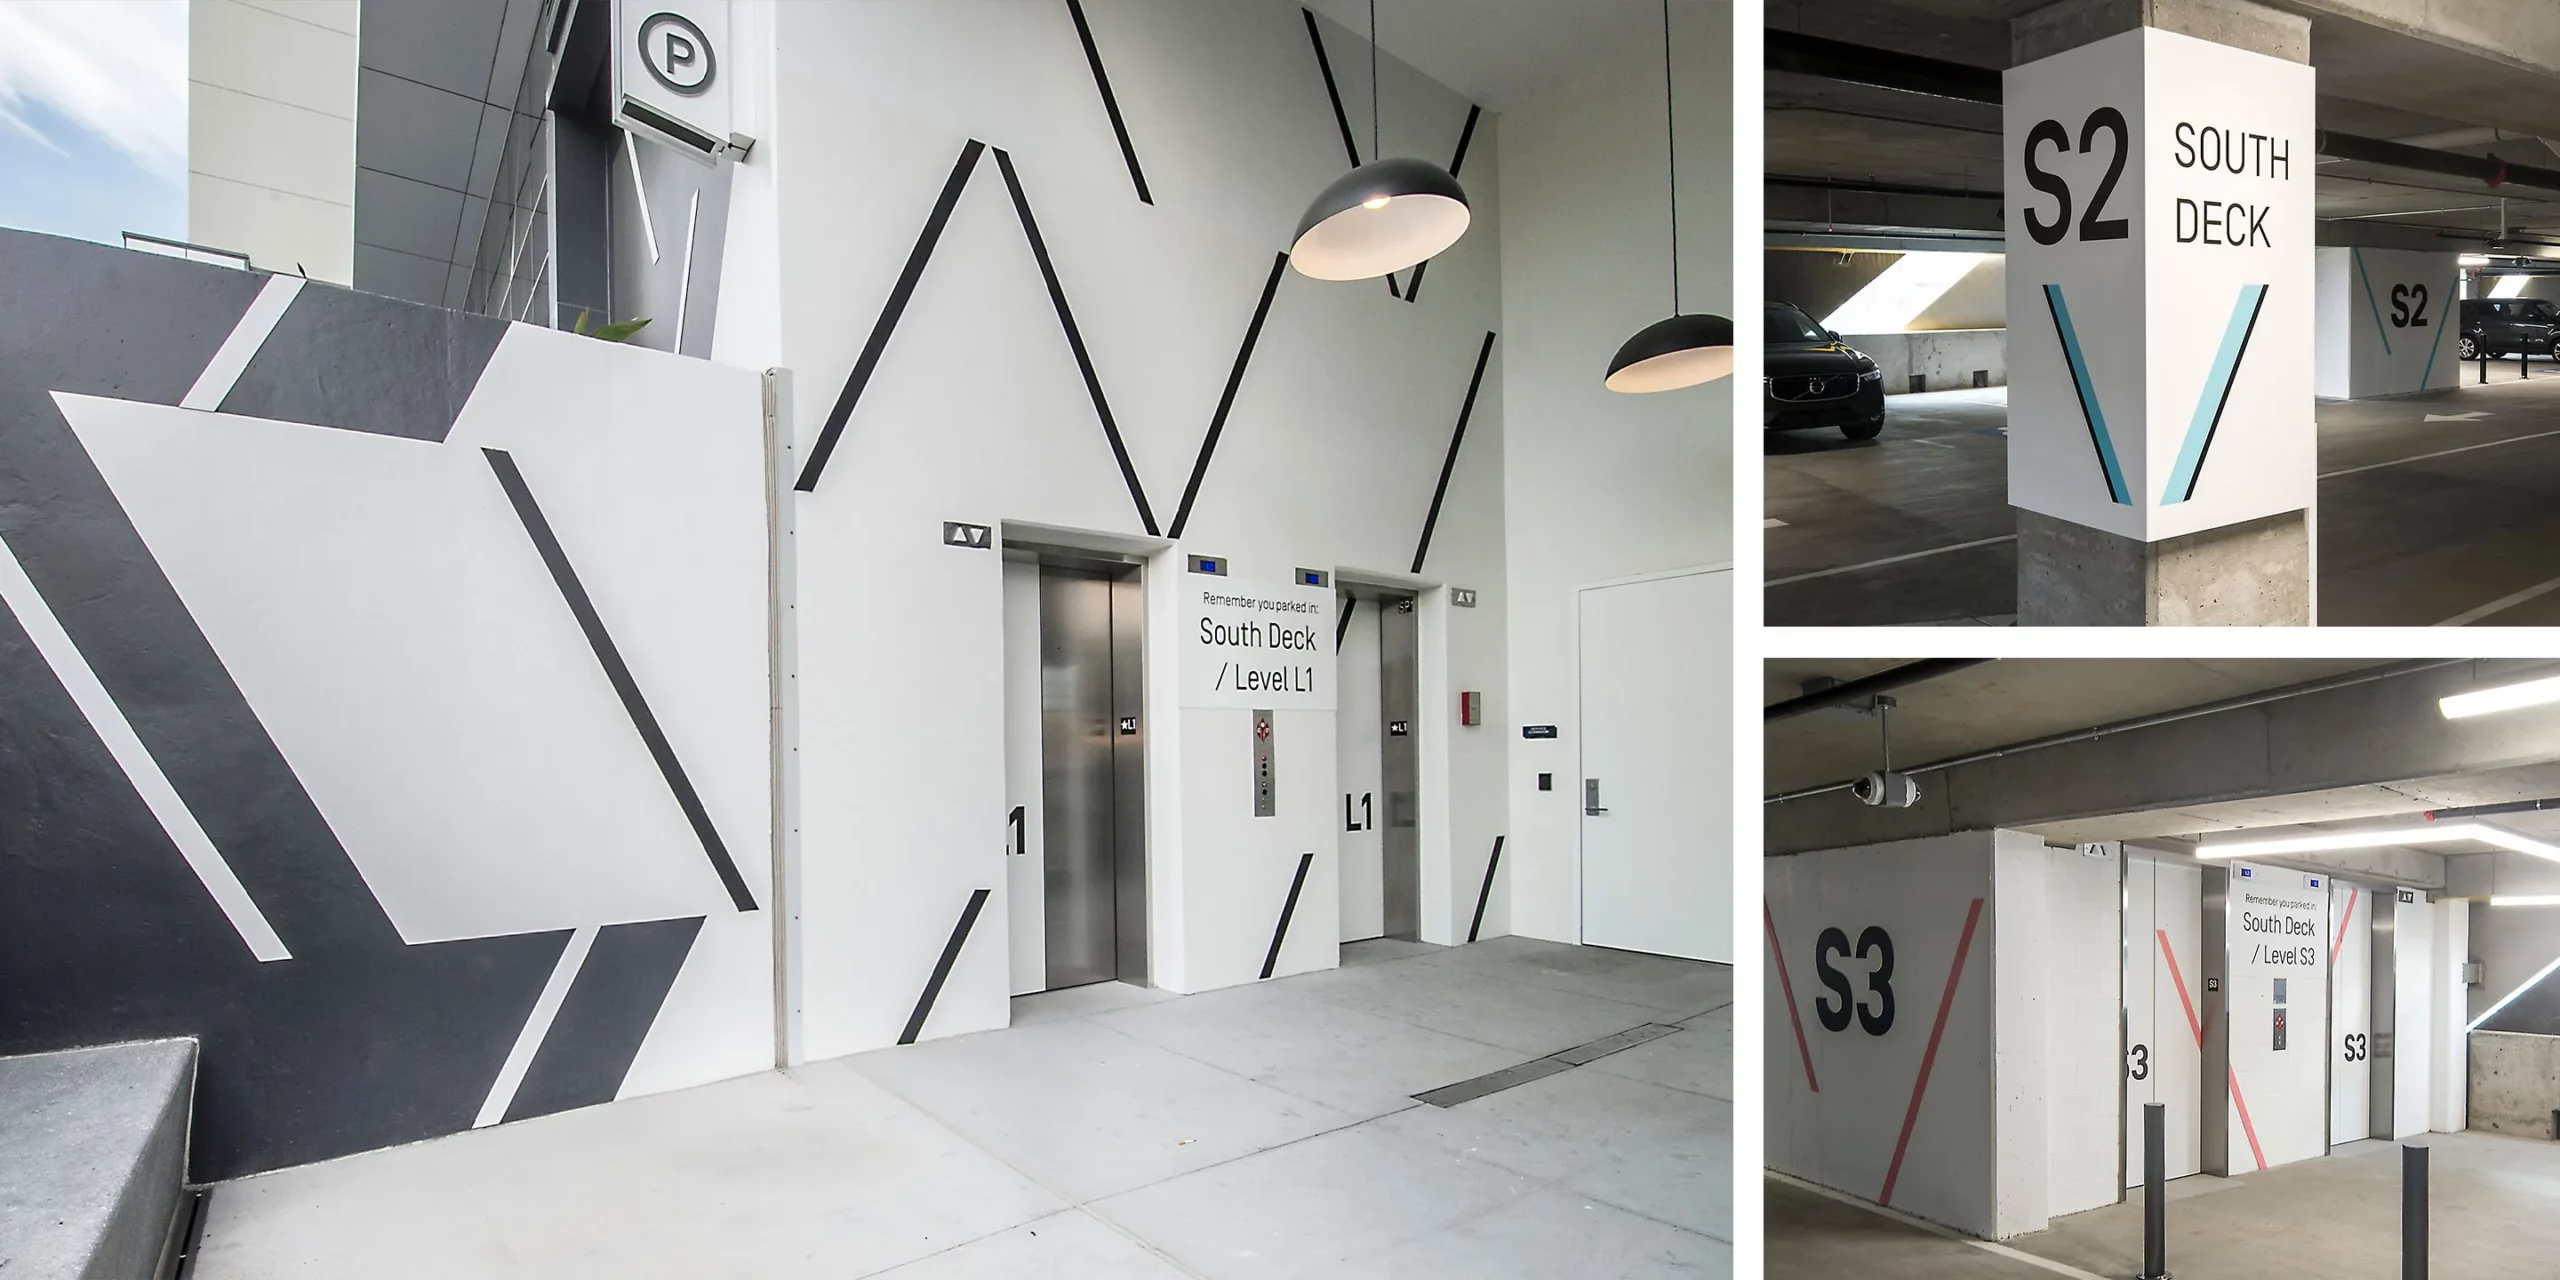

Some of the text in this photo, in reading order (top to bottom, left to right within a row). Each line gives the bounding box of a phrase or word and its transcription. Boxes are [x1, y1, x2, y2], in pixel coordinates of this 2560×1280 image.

[666, 32, 696, 75] P
[2174, 121, 2290, 181] SOUTH
[2023, 106, 2129, 246] S2
[2176, 197, 2272, 249] DECK
[2391, 283, 2428, 328] S2
[1203, 592, 1256, 608] Remember
[1258, 599, 1275, 612] you
[1276, 601, 1306, 613] parked
[1200, 617, 1316, 651] South Deck
[1215, 662, 1313, 692] / Level L1
[1345, 792, 1372, 832] L1
[1006, 806, 1025, 856] 1
[2245, 893, 2277, 906] Remember
[2279, 899, 2290, 908] you
[2243, 911, 2315, 936] South Deck
[2251, 943, 2315, 966] / Level S3
[1814, 925, 1896, 1040] S3
[2209, 979, 2218, 989] S3
[2126, 1044, 2149, 1081] 3
[2345, 1033, 2366, 1062] S3
